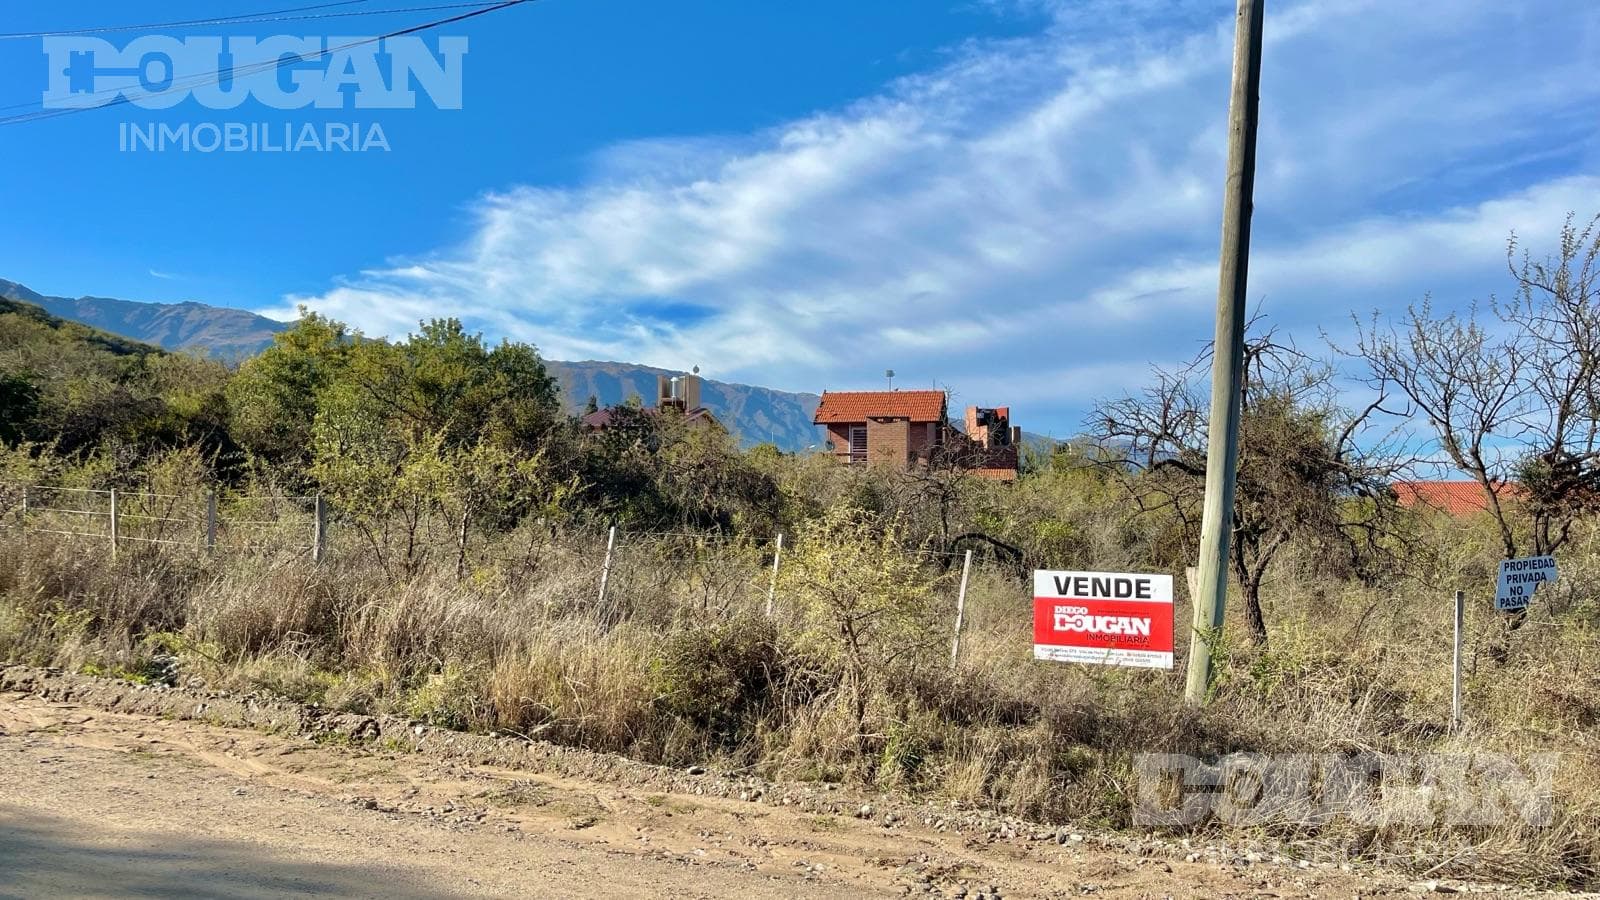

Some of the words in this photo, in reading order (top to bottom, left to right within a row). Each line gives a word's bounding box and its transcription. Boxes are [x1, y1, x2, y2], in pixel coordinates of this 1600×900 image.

[1504, 558, 1555, 572] PROPIEDAD
[1506, 571, 1547, 584] PRIVADA
[1053, 575, 1151, 599] VENDE
[1509, 585, 1524, 596] NO
[1500, 595, 1529, 608] PASAR
[1053, 605, 1088, 614] DIEGO
[1053, 613, 1151, 635] DOUGAN
[1086, 633, 1150, 643] INMOBILIARIA
